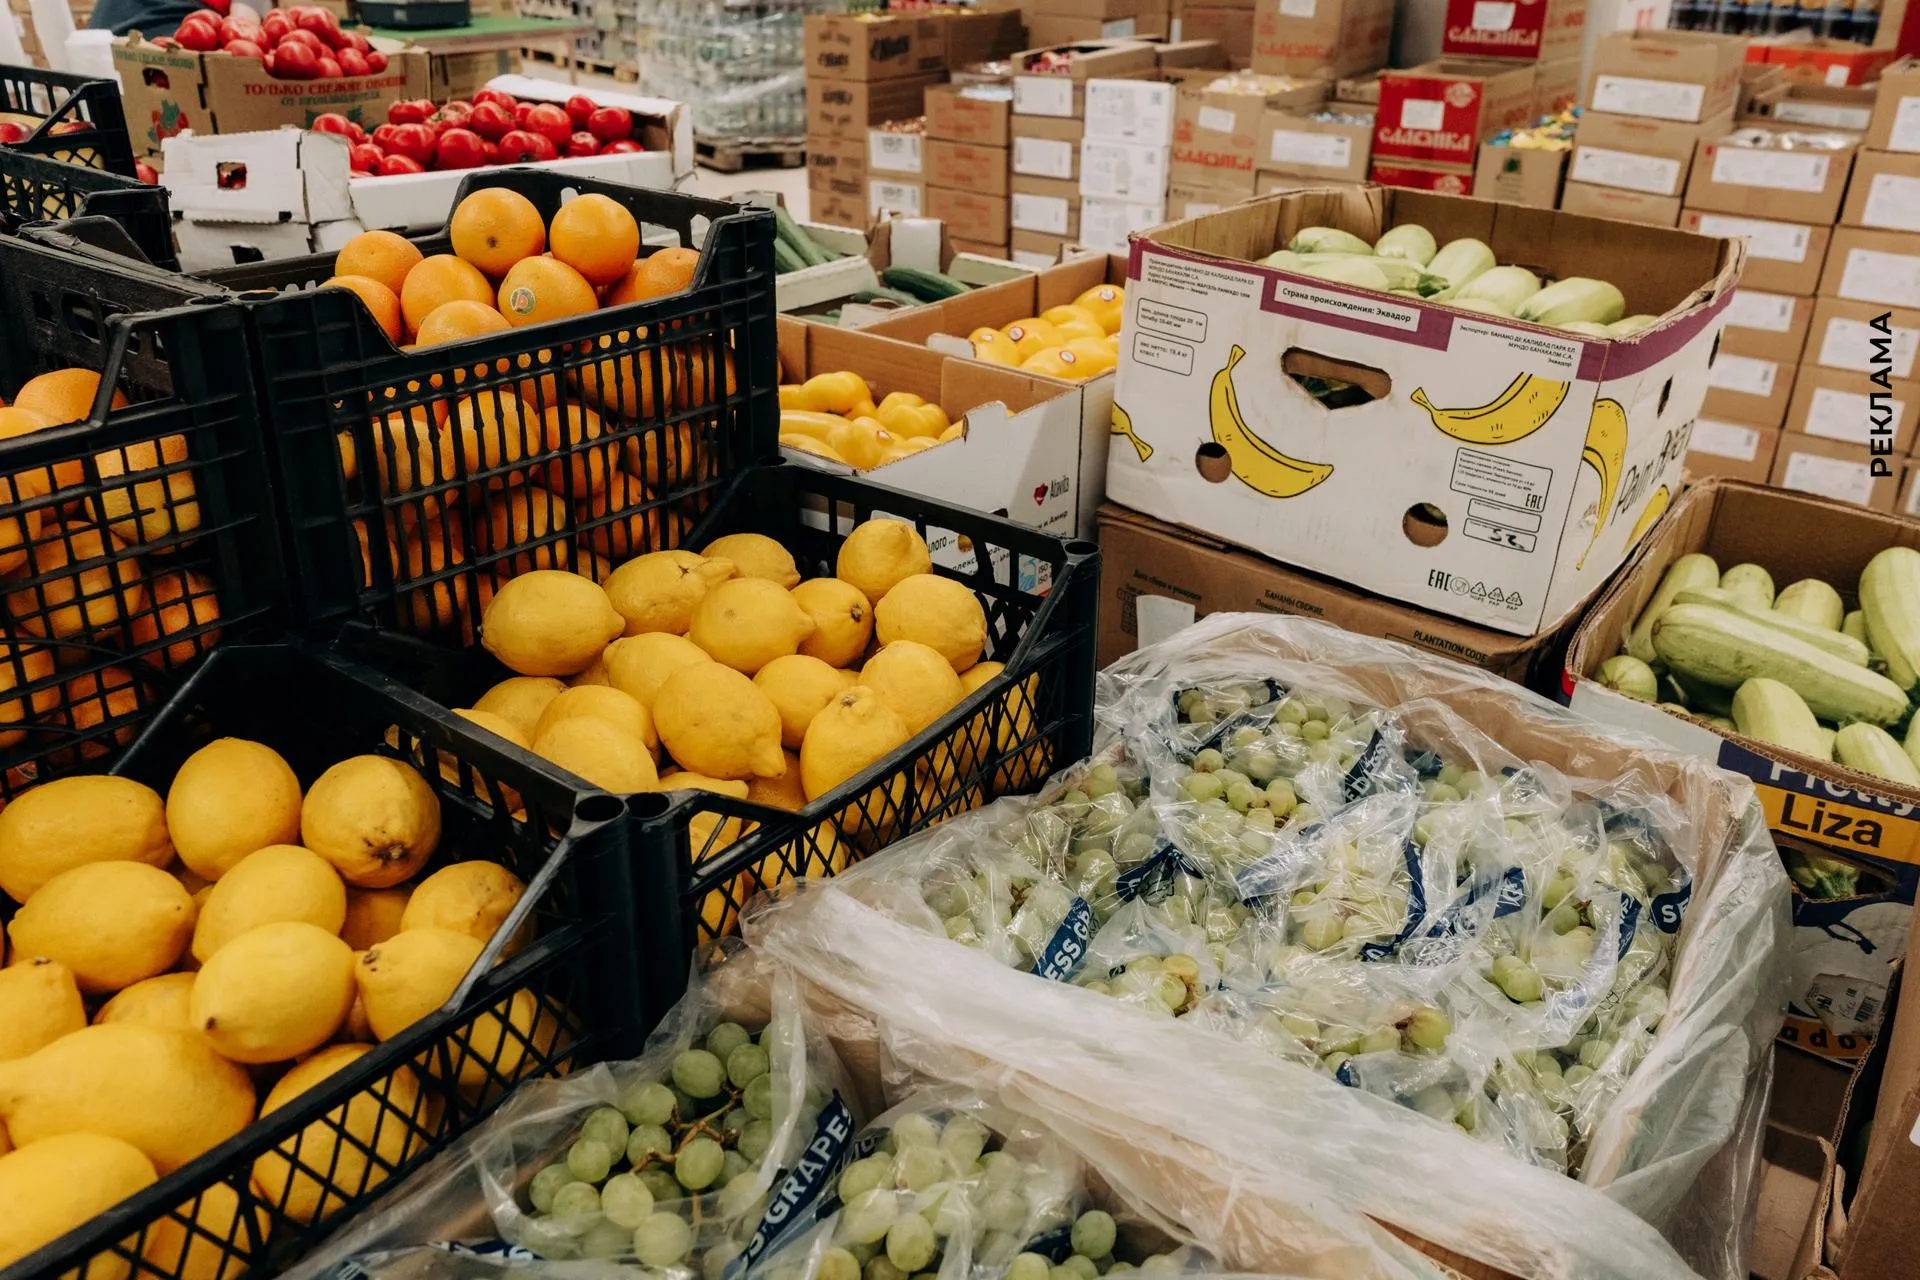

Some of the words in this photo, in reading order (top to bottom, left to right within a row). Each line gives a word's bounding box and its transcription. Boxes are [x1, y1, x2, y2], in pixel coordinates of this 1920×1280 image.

[243, 83, 304, 96] ТОЛЬКО
[1282, 288, 1309, 300] Страна
[1309, 295, 1375, 314] происхождения:
[1376, 308, 1412, 323] Эквадор
[1525, 493, 1543, 509] EAC
[1428, 568, 1452, 591] EAC
[1413, 630, 1465, 655] PLANTATION
[1465, 648, 1488, 663] CODE
[1780, 793, 1883, 848] Liza
